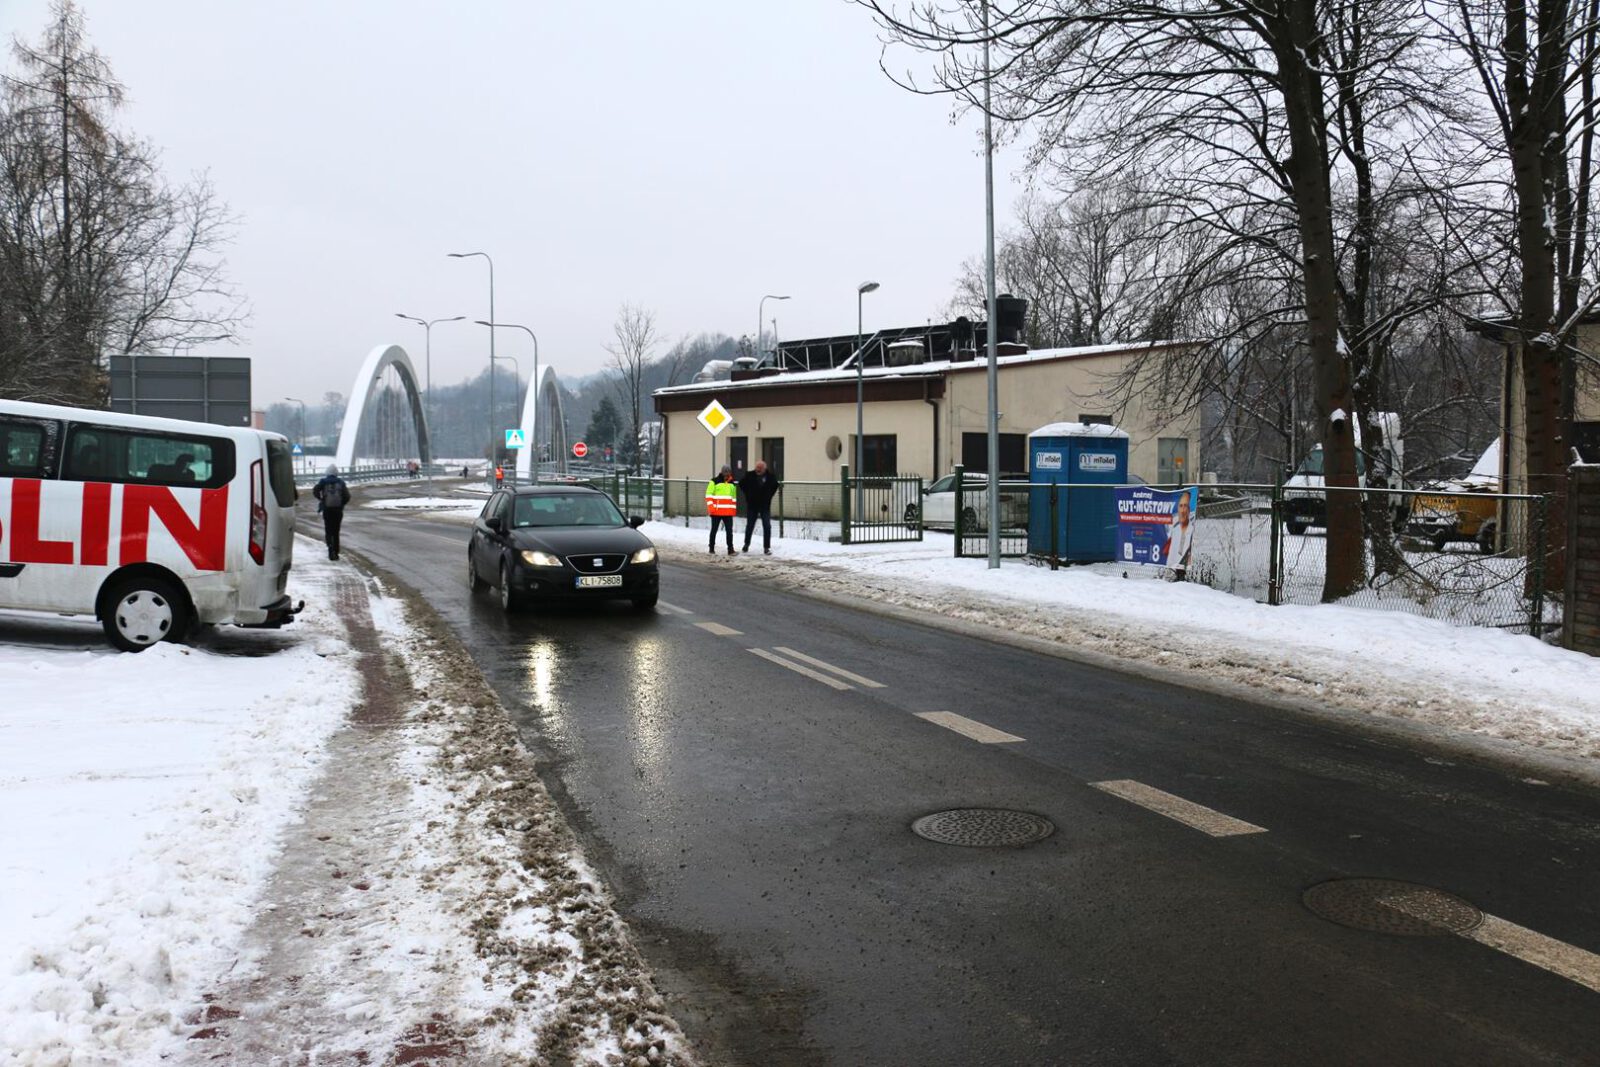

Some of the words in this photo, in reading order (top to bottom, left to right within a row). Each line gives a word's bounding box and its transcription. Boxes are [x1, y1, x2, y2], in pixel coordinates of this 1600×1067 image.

[1045, 455, 1060, 463] mToilet
[1093, 456, 1115, 464] mToilet
[1118, 500, 1176, 514] GUT-MOSTOWY
[0, 477, 229, 571] LIN
[1152, 544, 1160, 562] 8
